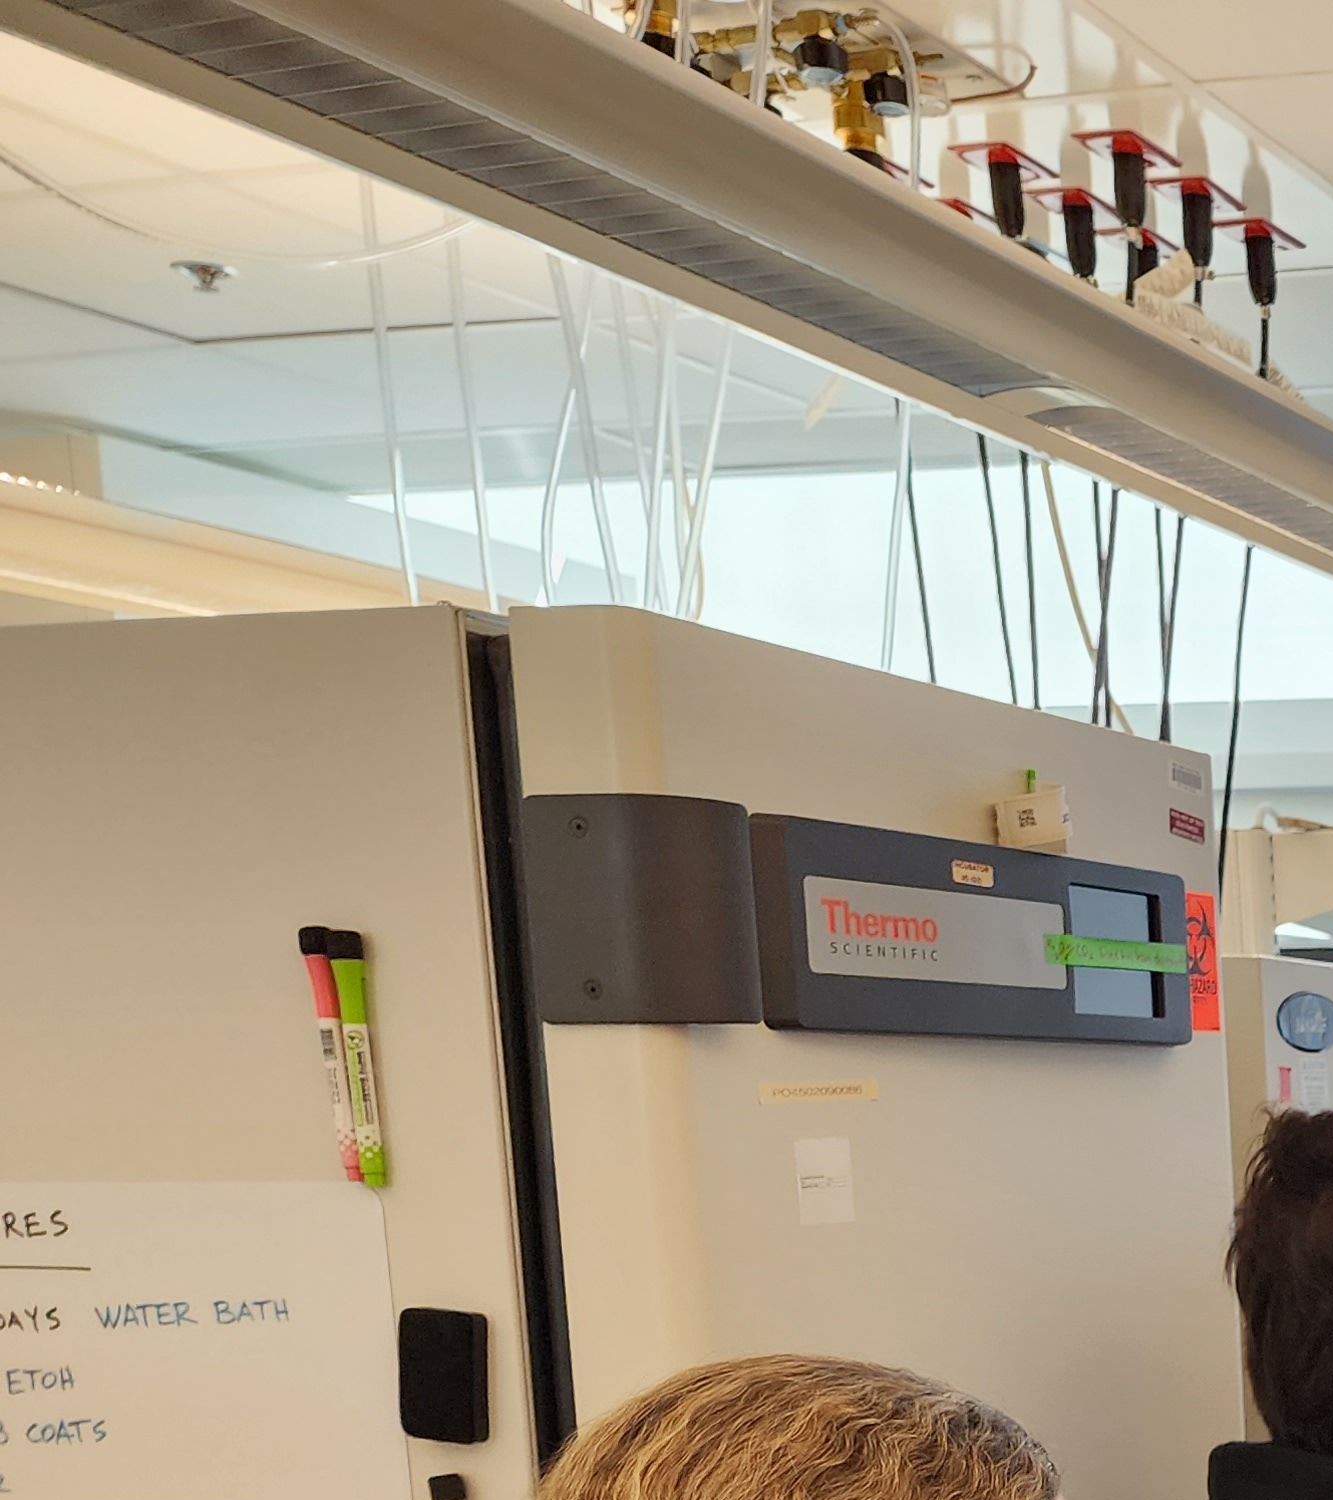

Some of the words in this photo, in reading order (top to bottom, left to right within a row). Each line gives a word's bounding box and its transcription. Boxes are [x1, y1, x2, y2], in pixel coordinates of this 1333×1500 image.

[820, 898, 938, 944] Thermo
[830, 941, 938, 962] SCIENTIFIC
[94, 1302, 198, 1329] WATER
[213, 1299, 290, 1324] BATH
[6, 1365, 75, 1395] ETOH
[26, 1419, 107, 1445] COATS
